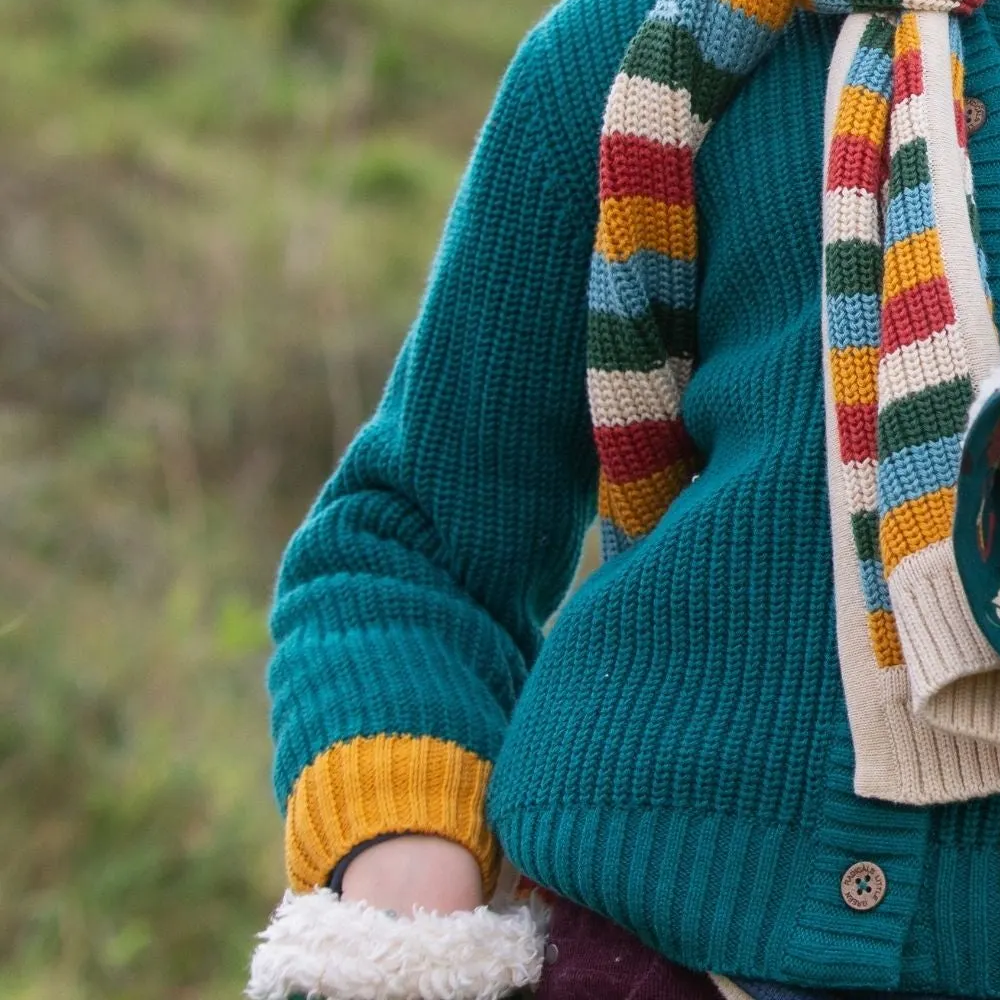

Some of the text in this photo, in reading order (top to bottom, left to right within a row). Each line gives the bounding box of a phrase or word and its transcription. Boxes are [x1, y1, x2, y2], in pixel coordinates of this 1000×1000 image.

[844, 864, 883, 907] LITTLE GREEN RADICALS
